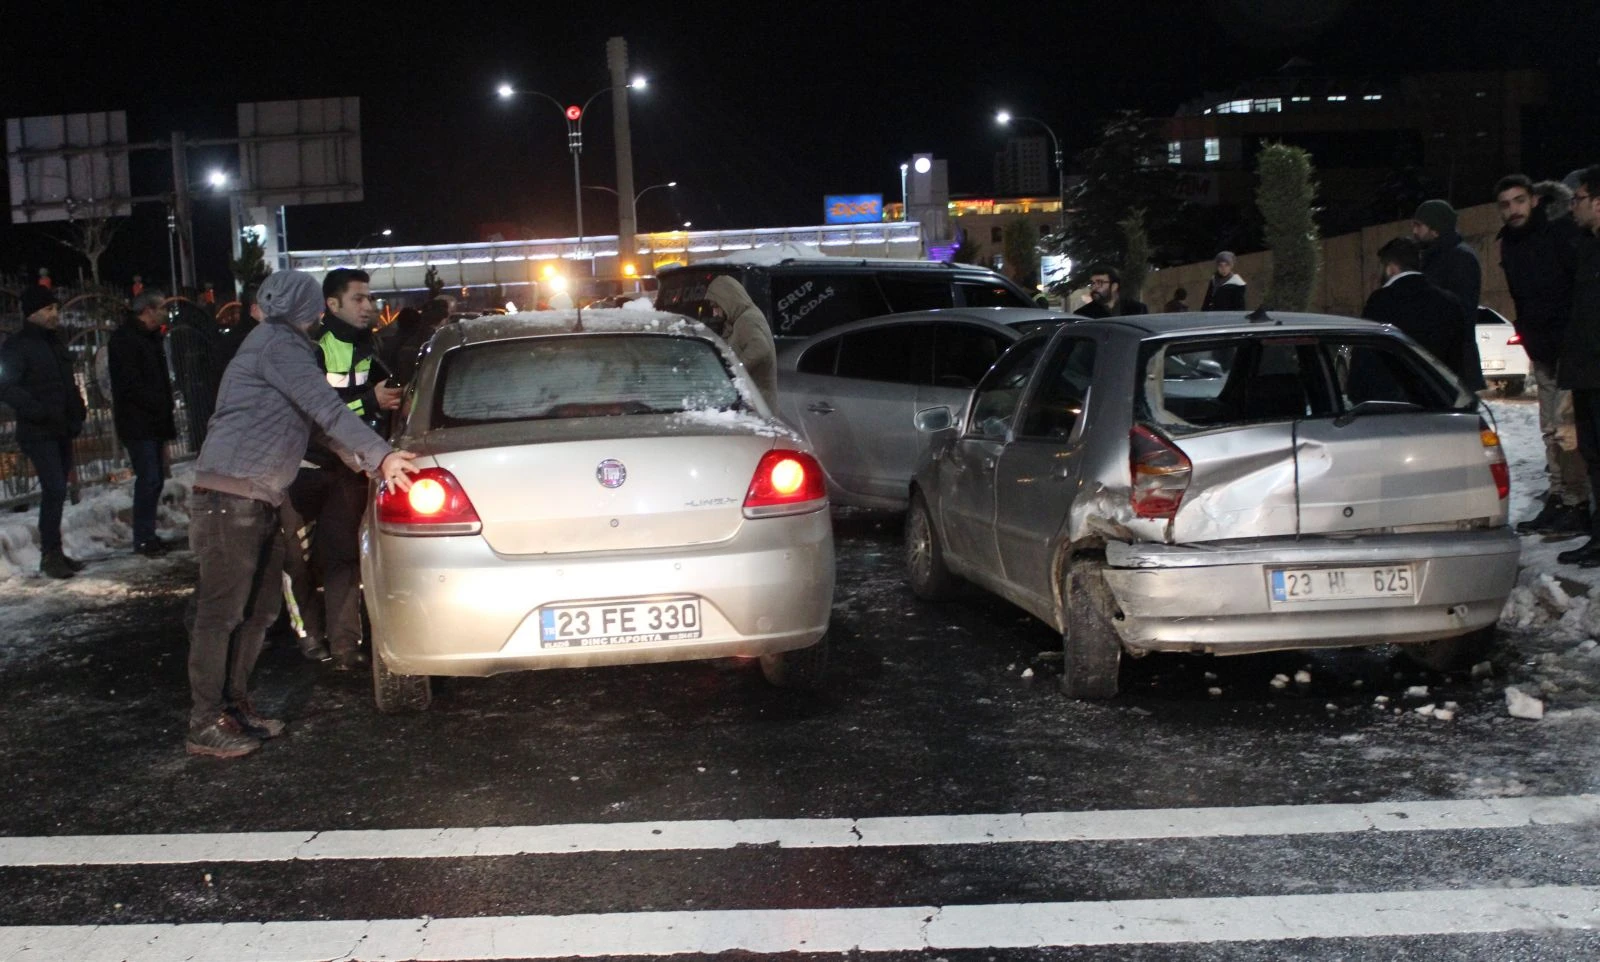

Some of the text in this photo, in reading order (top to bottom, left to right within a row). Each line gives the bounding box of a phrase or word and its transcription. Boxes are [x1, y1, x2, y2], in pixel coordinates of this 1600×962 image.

[777, 281, 813, 311] GRUP
[1287, 573, 1312, 597] 23
[1373, 568, 1409, 592] 625
[558, 603, 697, 637] 23 FE 330
